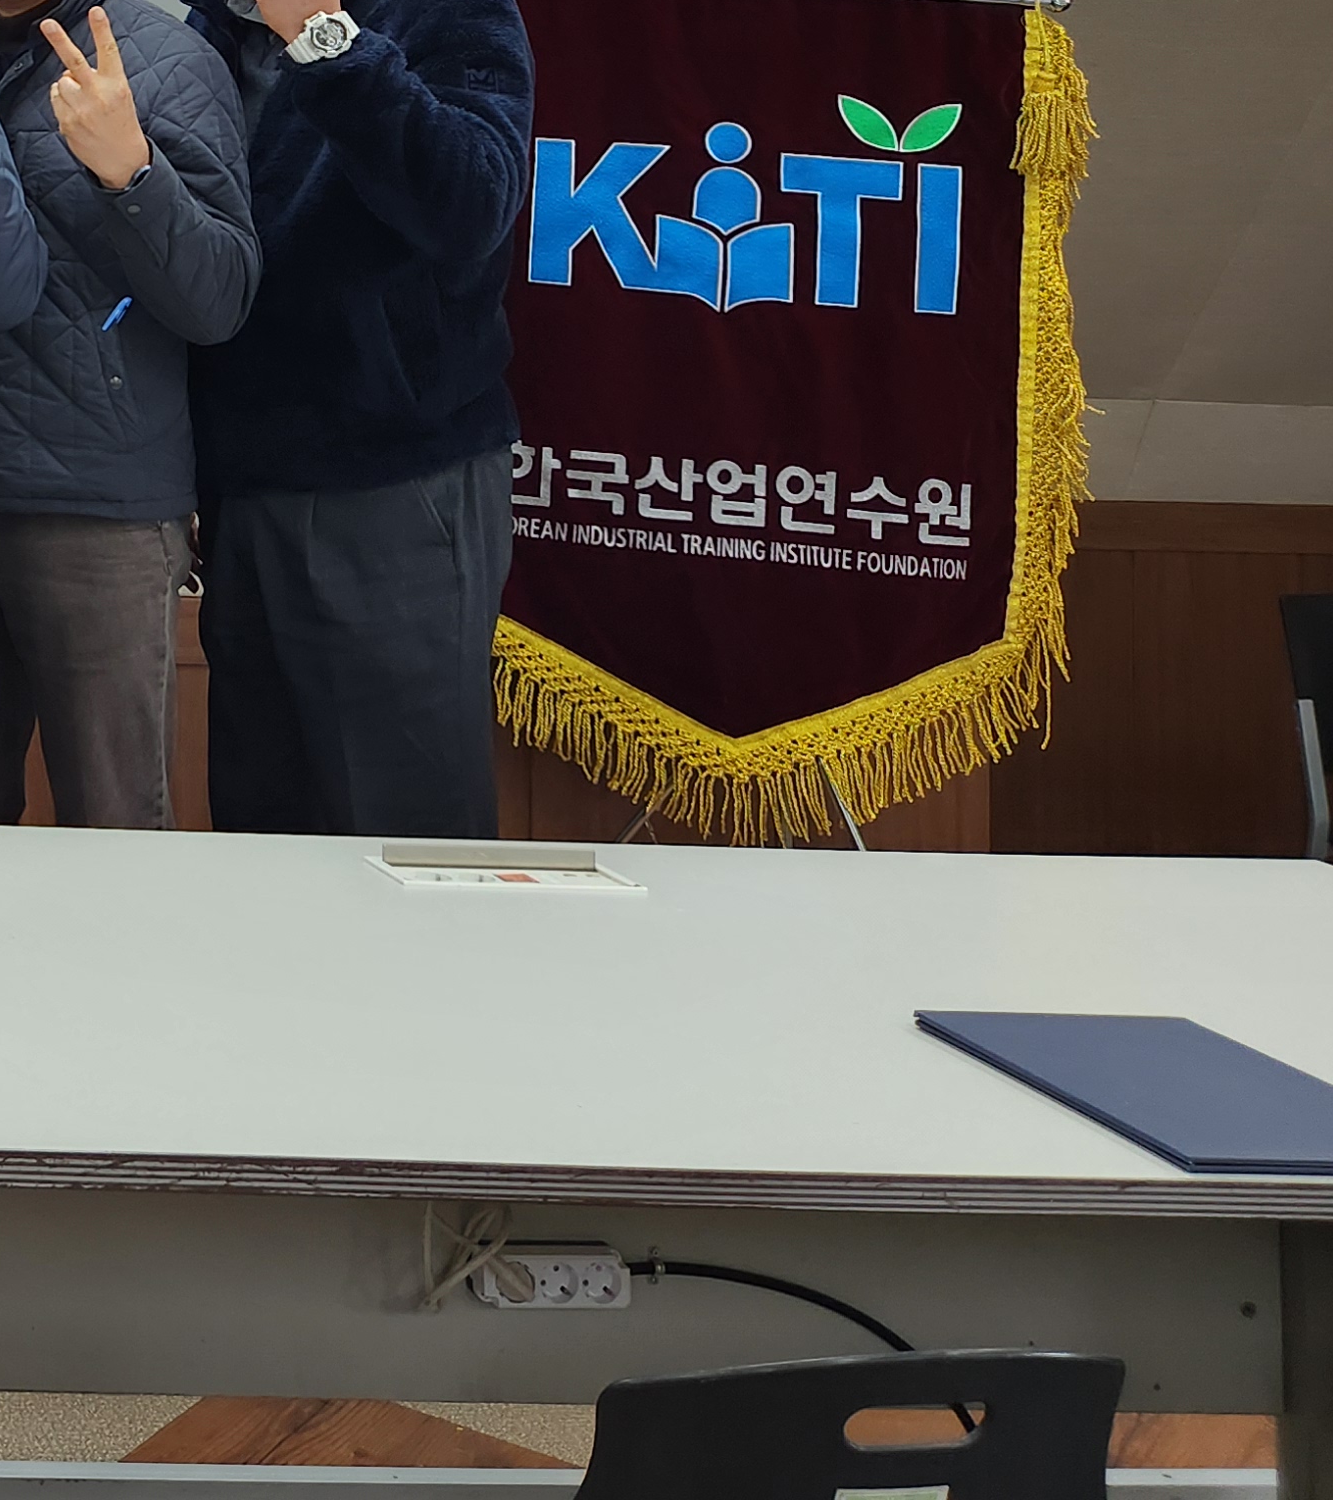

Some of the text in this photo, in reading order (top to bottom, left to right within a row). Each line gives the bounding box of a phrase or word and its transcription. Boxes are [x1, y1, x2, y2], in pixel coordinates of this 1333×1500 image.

[511, 440, 973, 547] 한국산업연수원
[571, 522, 678, 554] INDUSTRIAL
[681, 532, 767, 562] TRAINING
[769, 542, 853, 571] INSTITUTE
[856, 551, 968, 581] FOUNDATION
